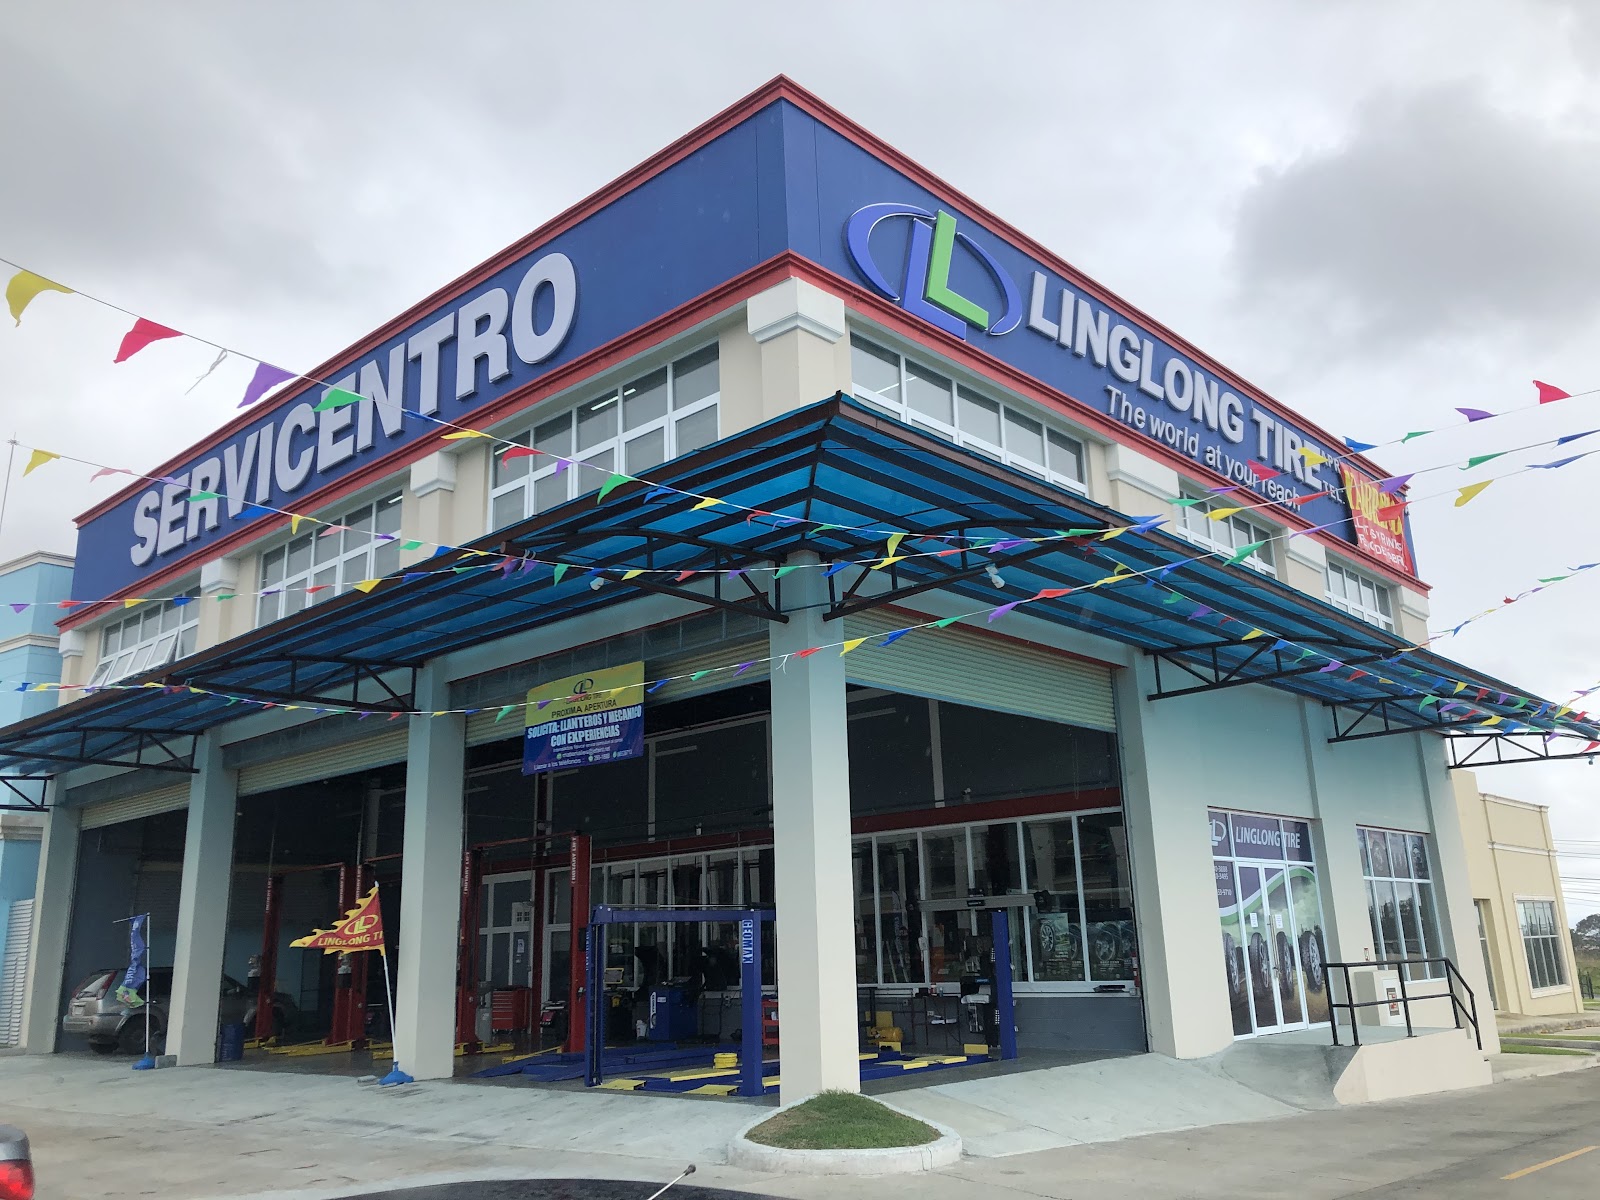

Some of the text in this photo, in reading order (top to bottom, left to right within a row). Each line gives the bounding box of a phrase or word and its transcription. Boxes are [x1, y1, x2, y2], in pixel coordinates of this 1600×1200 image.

[1027, 271, 1322, 492] LINGLONG TIRE
[130, 252, 578, 568] SERVICENTRO
[1104, 385, 1301, 511] The world at your reach
[552, 699, 617, 718] PROXIMA APERTURA
[527, 721, 560, 739] SOLICITA:
[560, 713, 602, 731] LLANTEROS
[601, 713, 608, 724] Y
[551, 732, 567, 747] CON
[567, 724, 620, 744] EXPERIENCIAS
[1236, 826, 1301, 849] LINGLONG TIRE
[318, 934, 370, 946] LINGLONG
[742, 919, 754, 964] GEOMAX
